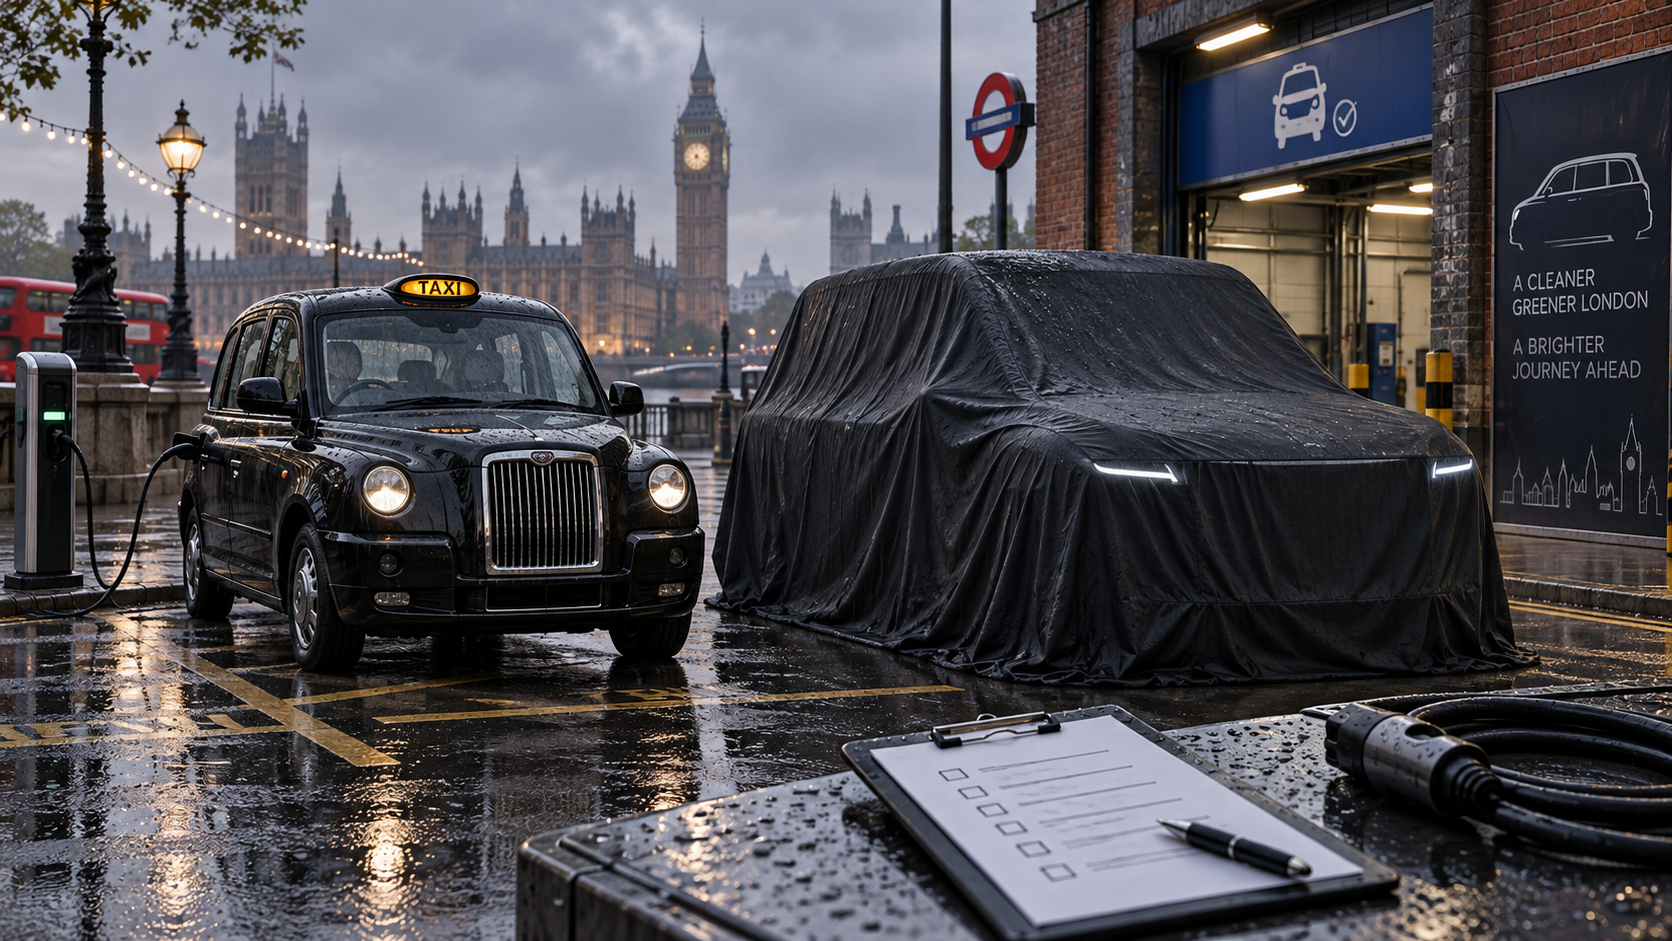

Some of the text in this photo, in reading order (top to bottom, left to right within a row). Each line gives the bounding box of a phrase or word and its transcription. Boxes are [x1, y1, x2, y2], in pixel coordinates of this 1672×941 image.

[418, 281, 461, 296] TAXI
[1513, 268, 1595, 292] A CLEANER
[1512, 290, 1648, 316] GREENER LONDON
[1513, 335, 1605, 355] A BRIGHTER
[1512, 360, 1641, 380] JOURNEY AHEAD
